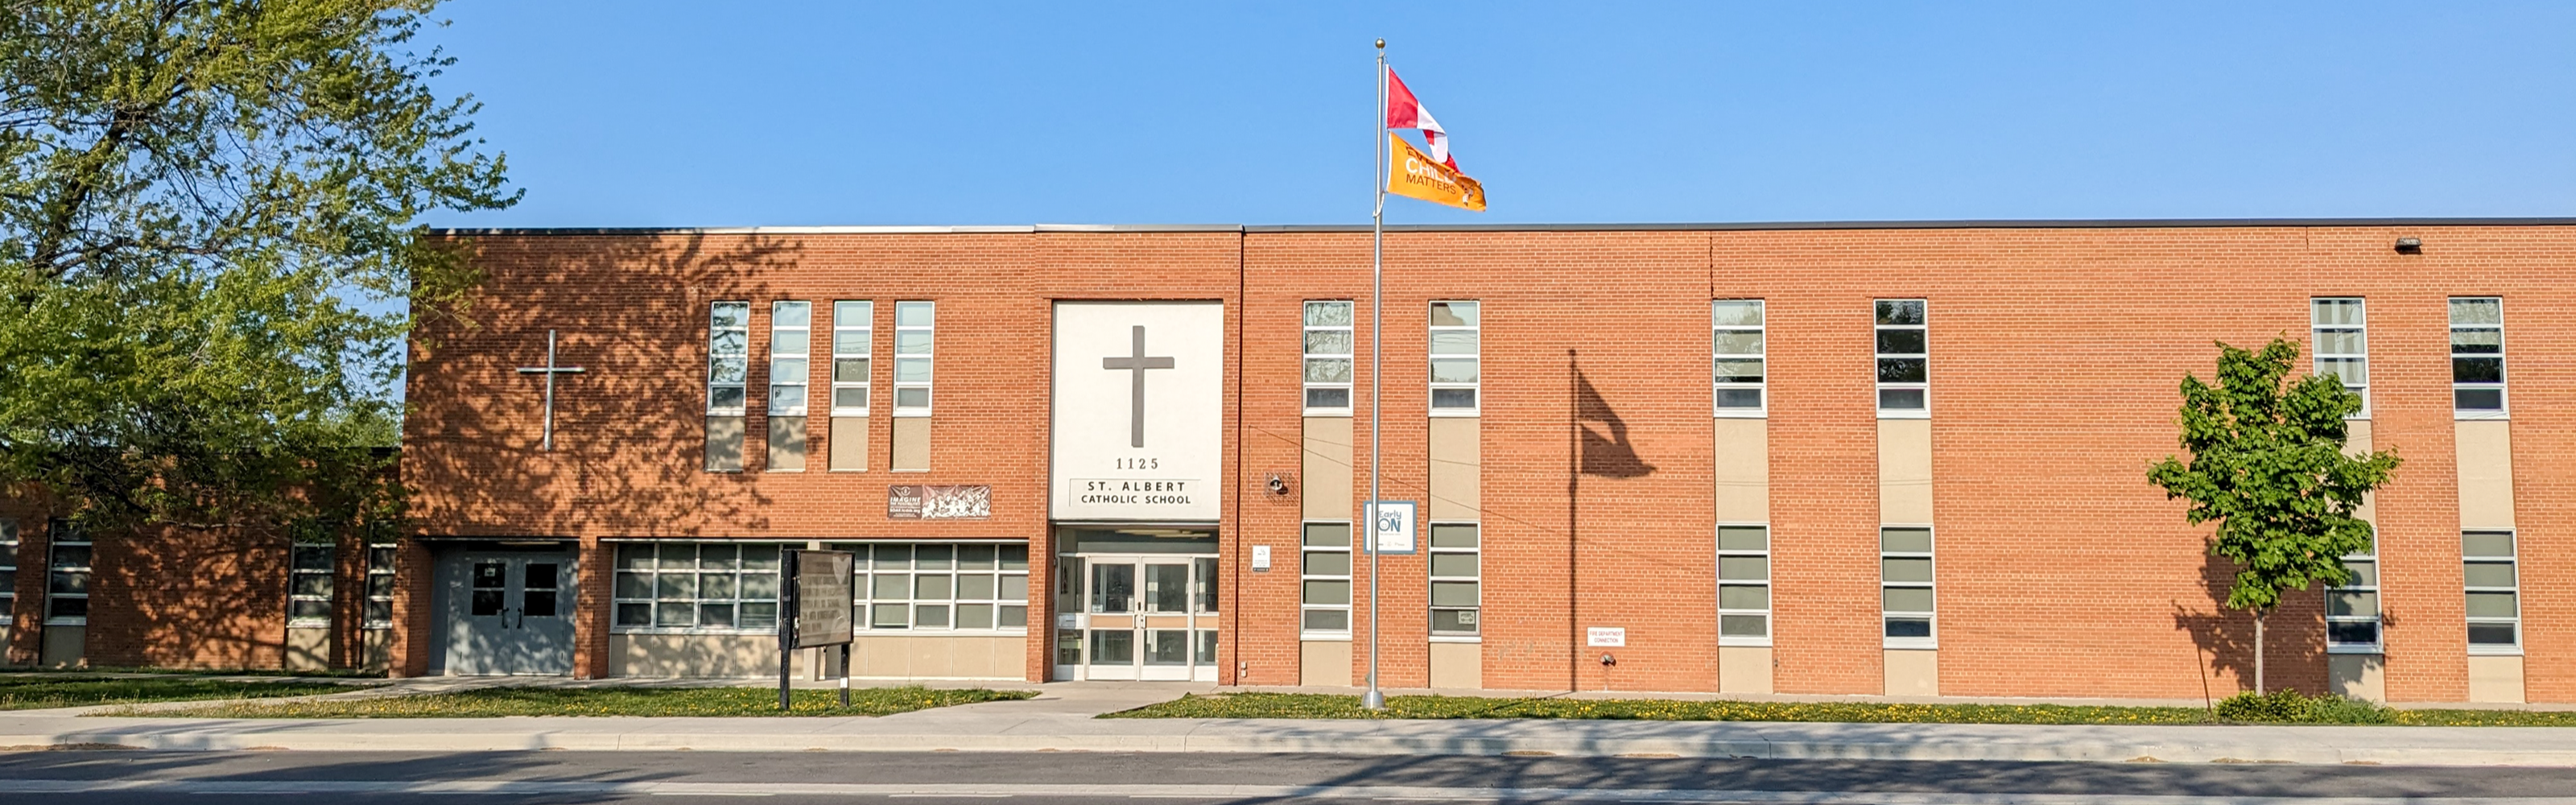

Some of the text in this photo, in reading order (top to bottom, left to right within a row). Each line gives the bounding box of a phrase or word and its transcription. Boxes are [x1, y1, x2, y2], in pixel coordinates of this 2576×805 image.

[1406, 173, 1456, 195] MATTERS
[1117, 458, 1158, 469] 1125
[1088, 481, 1186, 492] ST. ALBERT
[1081, 495, 1191, 504] CATHOLIC SCHOOL
[1379, 510, 1402, 519] Early
[1378, 518, 1401, 532] ON
